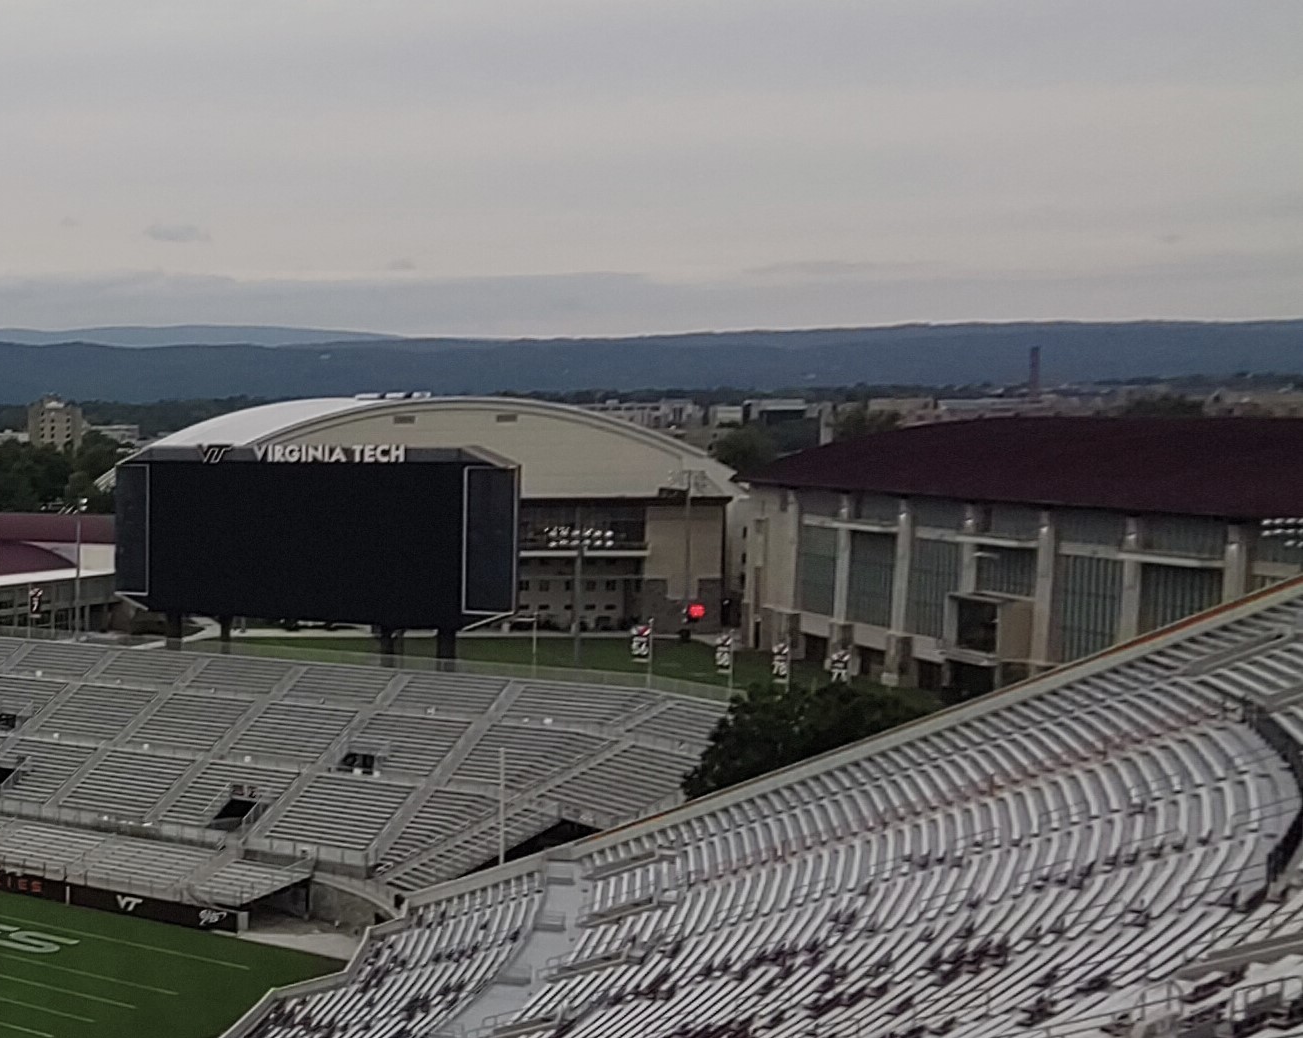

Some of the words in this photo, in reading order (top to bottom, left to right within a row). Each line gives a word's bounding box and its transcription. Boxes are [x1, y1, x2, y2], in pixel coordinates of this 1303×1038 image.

[197, 443, 234, 464] VT
[252, 443, 346, 464] VIRGINIA
[352, 443, 406, 464] TECH
[116, 895, 143, 912] VT
